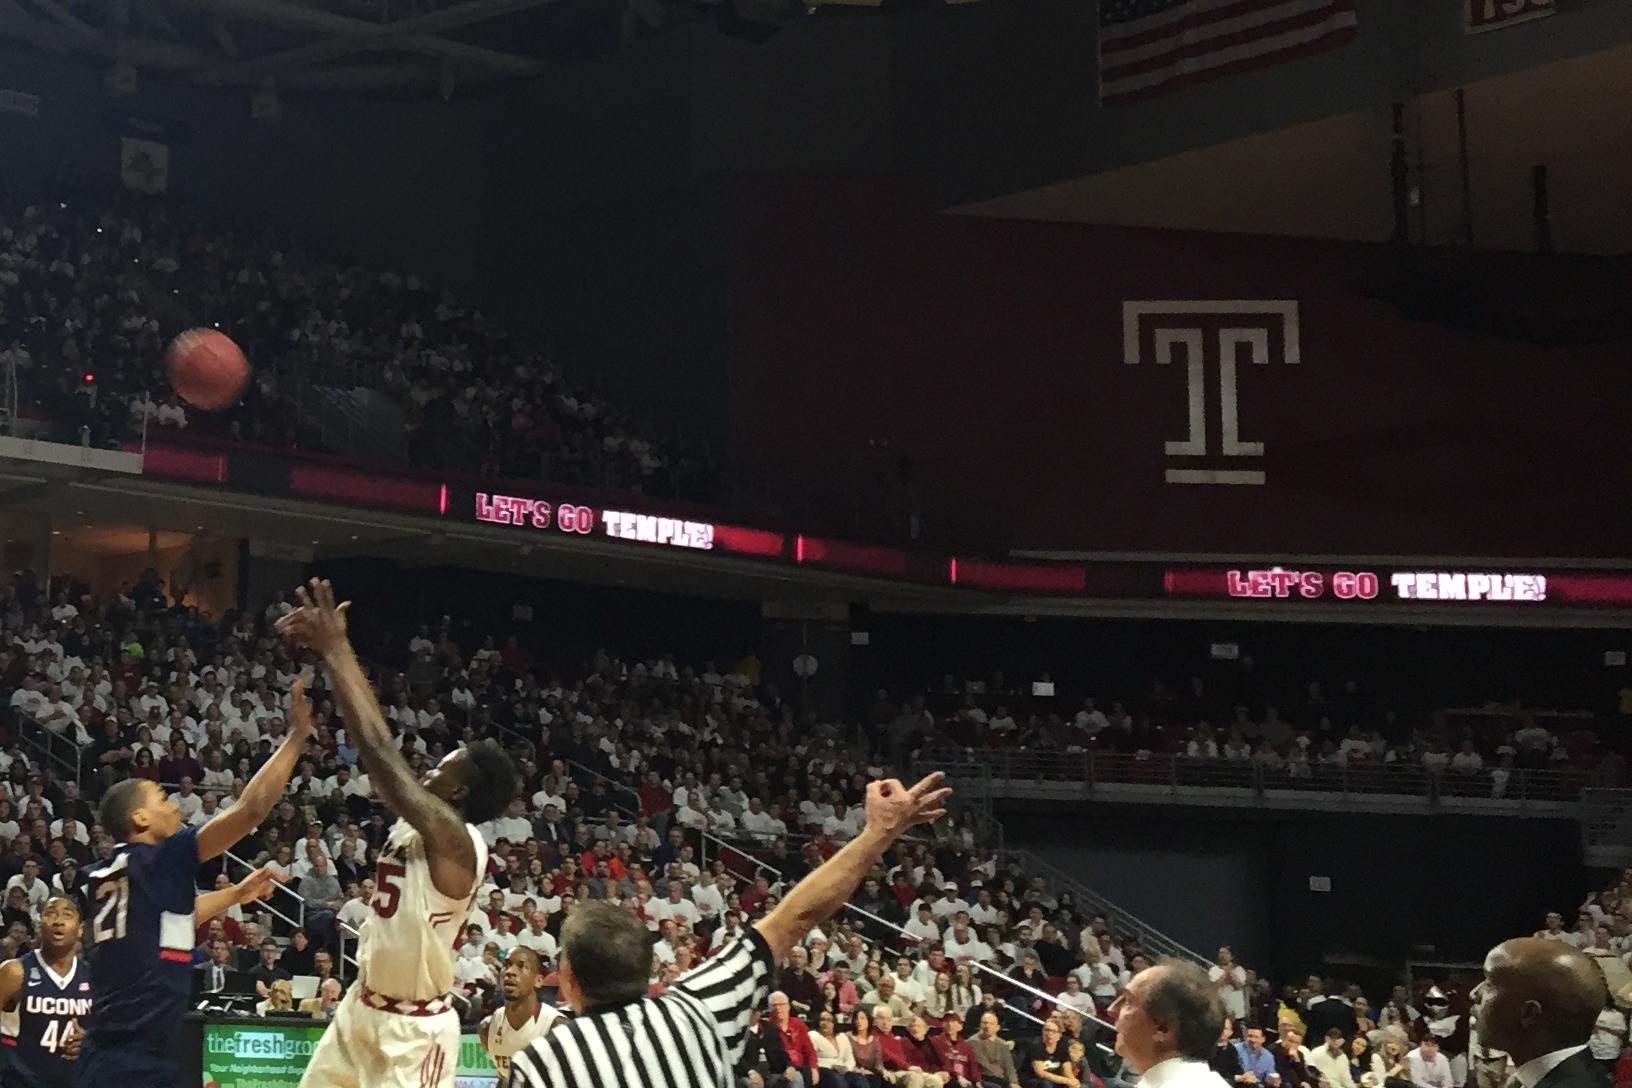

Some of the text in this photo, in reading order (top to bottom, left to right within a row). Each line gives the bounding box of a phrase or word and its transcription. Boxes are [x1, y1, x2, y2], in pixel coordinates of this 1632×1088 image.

[476, 492, 714, 550] LET'S GO TEMPLE!
[1226, 570, 1546, 601] LET'S GO TEMPLE!
[93, 876, 129, 944] 21
[26, 996, 92, 1016] UCONN
